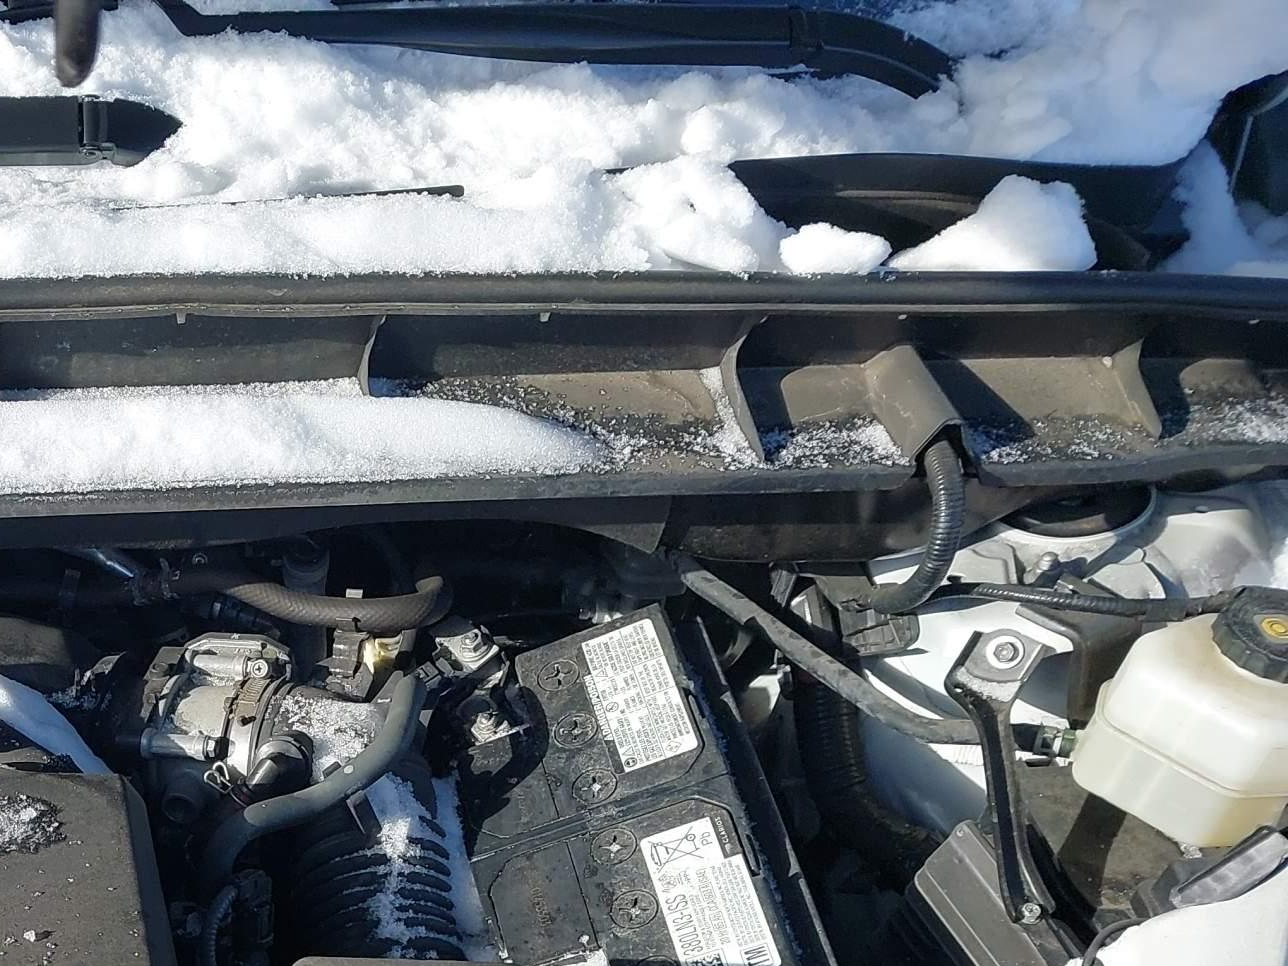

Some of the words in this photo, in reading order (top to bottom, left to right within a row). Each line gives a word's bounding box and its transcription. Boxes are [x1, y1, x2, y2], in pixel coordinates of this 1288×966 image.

[700, 831, 713, 847] Pb
[714, 816, 729, 843] CLARIOS
[663, 893, 704, 956] 380LN3-ISS
